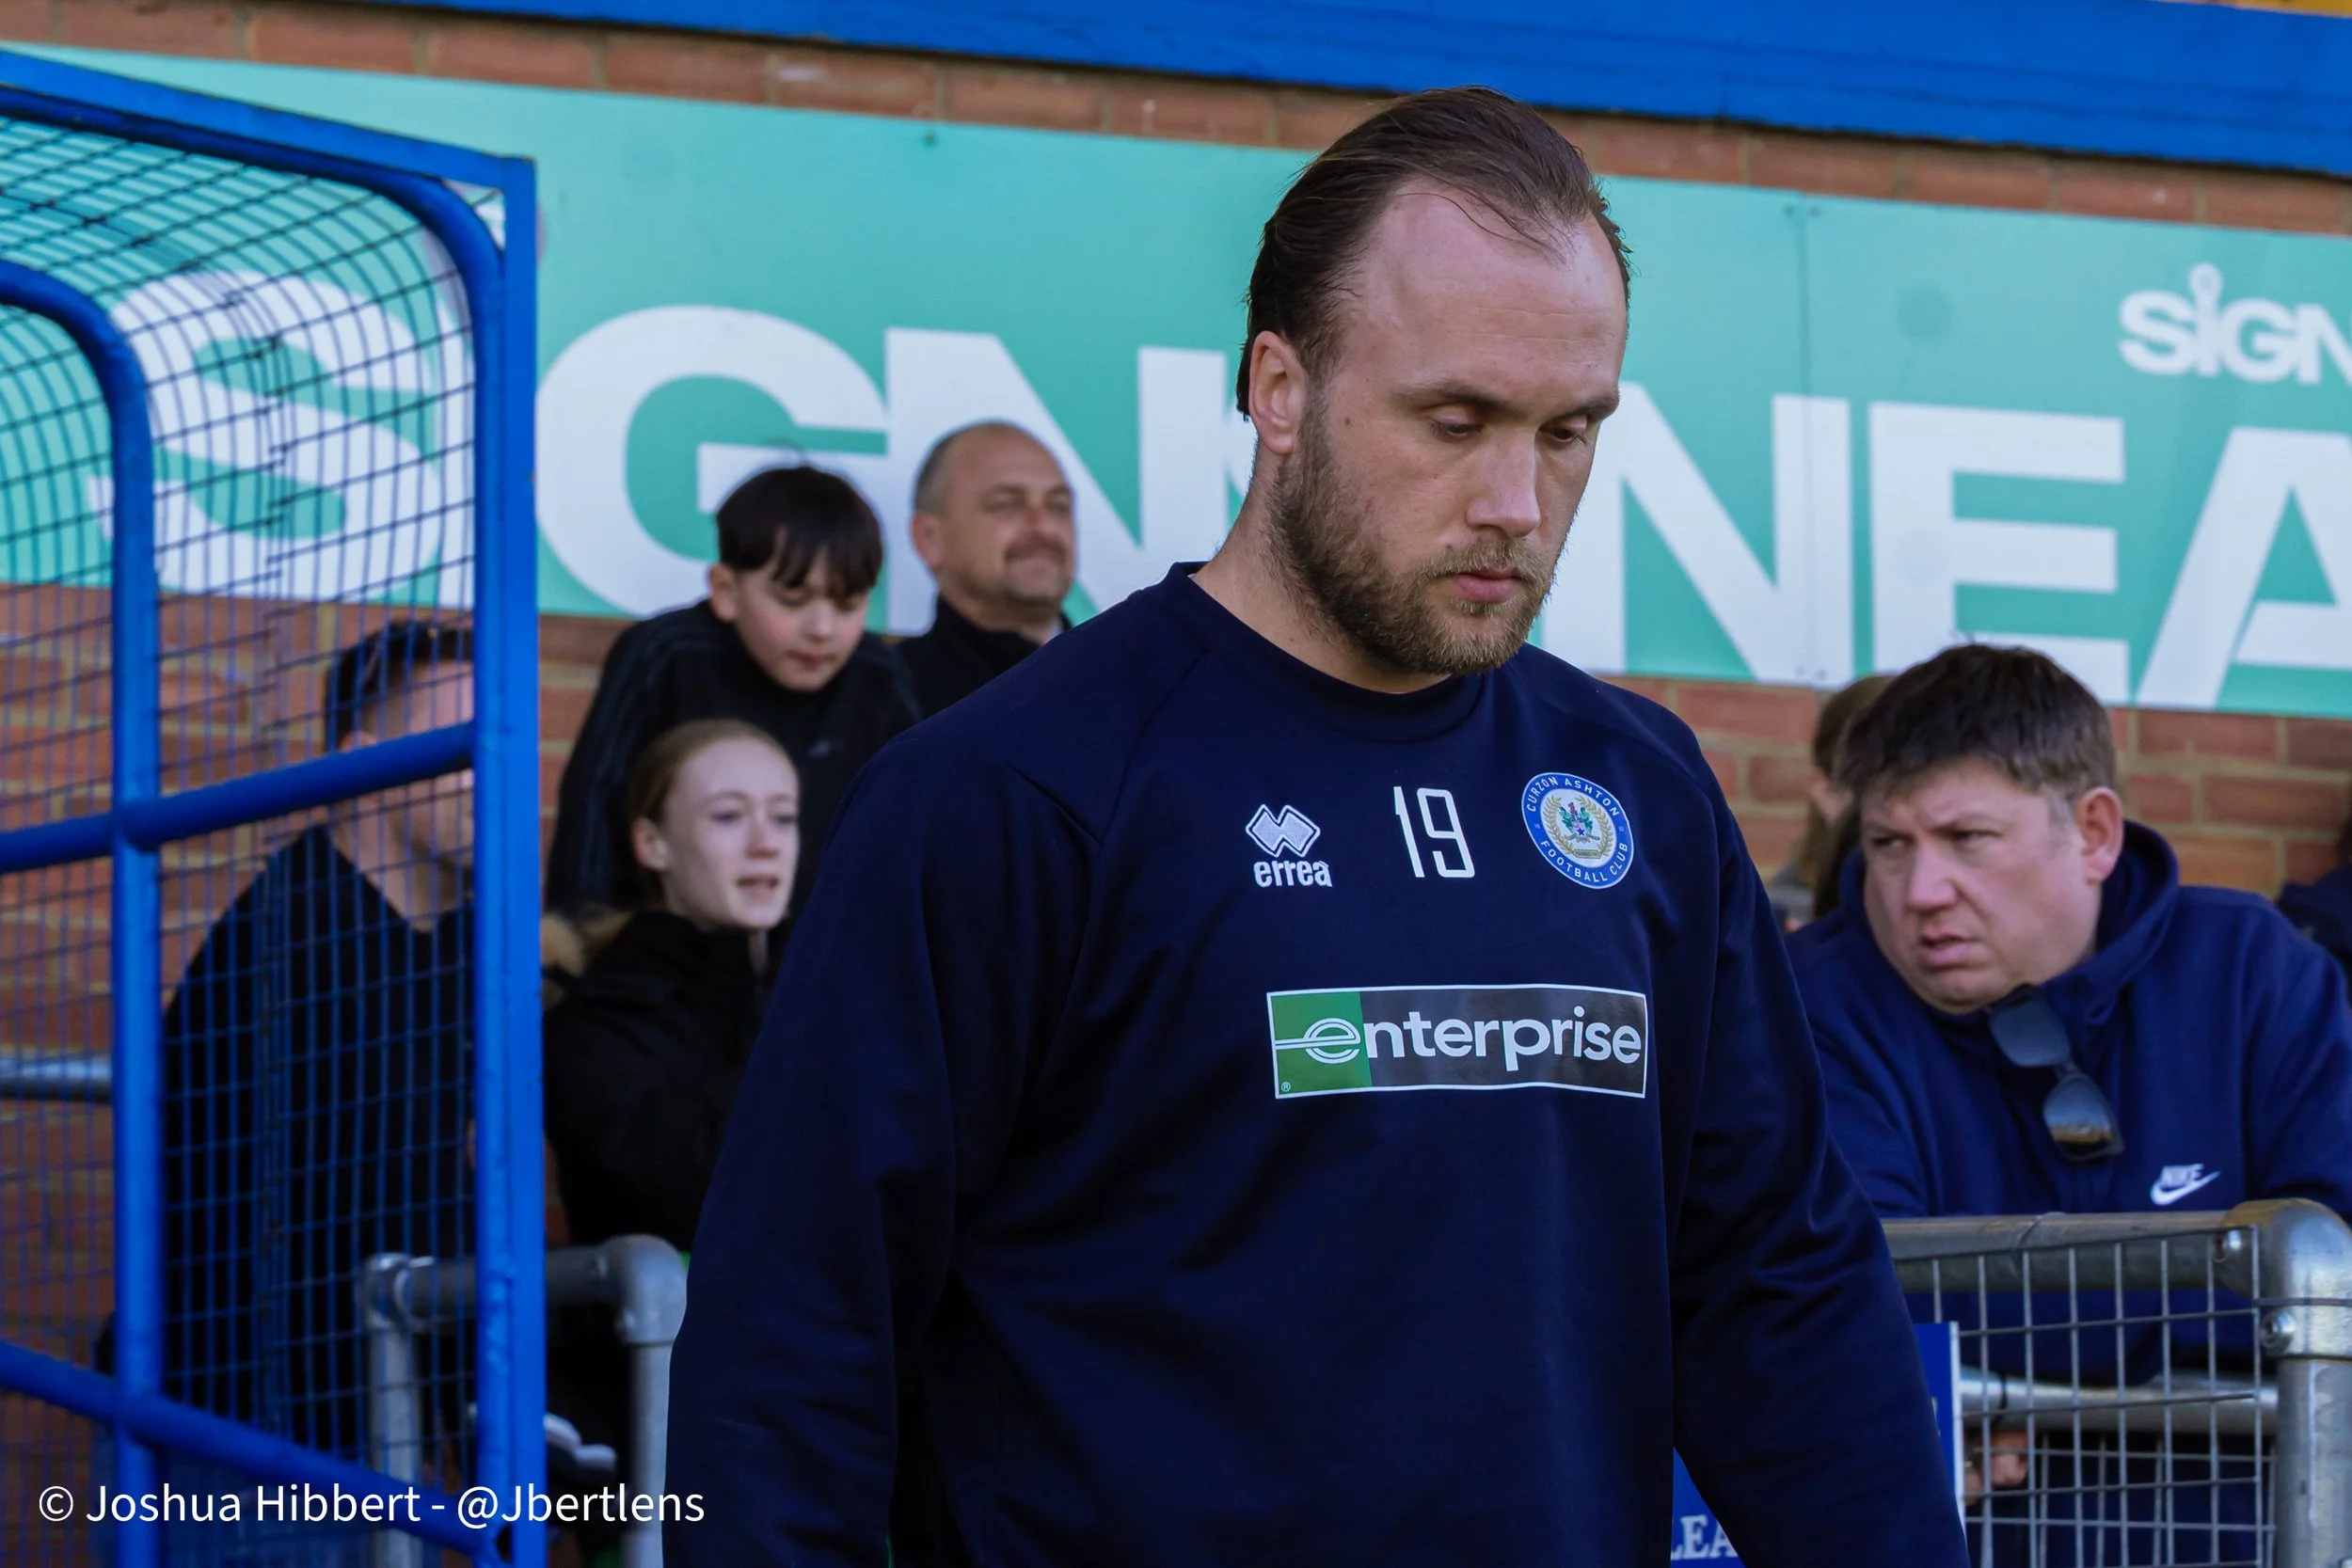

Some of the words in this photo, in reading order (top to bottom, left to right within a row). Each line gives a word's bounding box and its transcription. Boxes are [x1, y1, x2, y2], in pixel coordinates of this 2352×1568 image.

[1526, 777, 1559, 812] CURZON
[1565, 778, 1619, 816] ASHTON
[1394, 786, 1475, 878] 19
[1541, 840, 1608, 882] FOOTBALL
[1610, 843, 1628, 876] CLUB
[1277, 1006, 1642, 1071] enterprise
